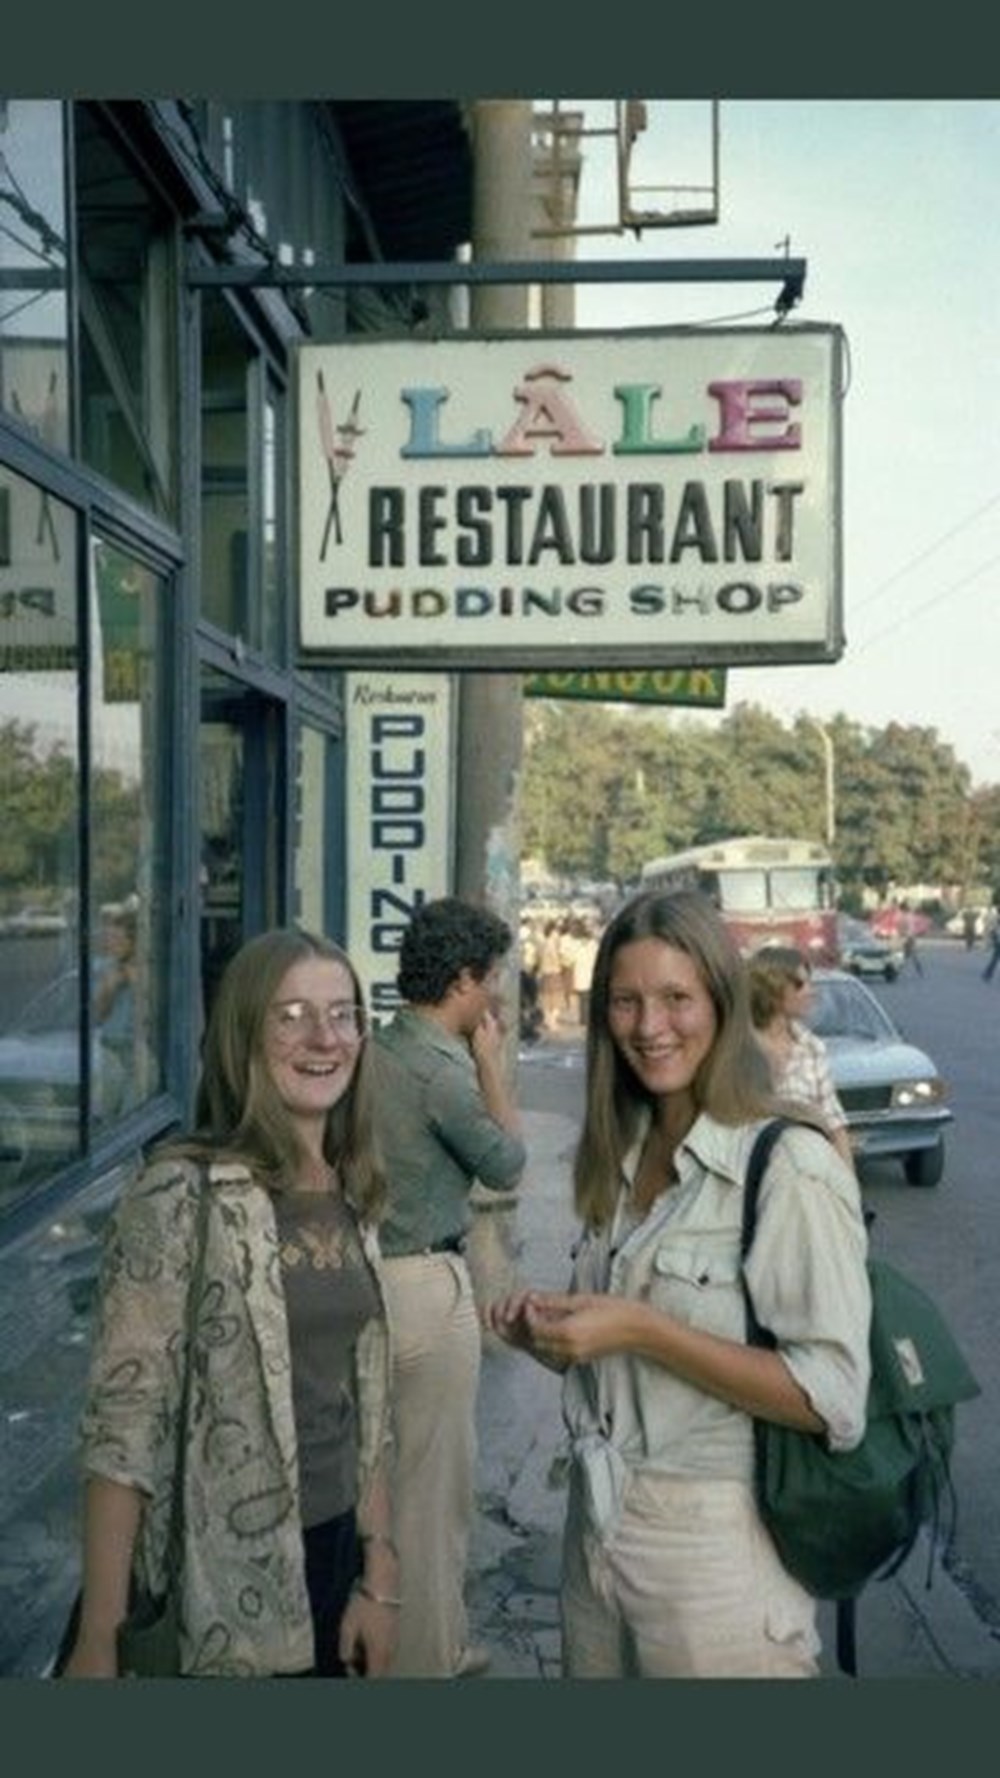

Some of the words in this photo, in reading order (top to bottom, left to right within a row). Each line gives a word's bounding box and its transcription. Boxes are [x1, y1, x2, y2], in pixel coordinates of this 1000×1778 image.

[399, 366, 804, 458] LÂLE
[367, 479, 805, 569] RESTAURANT
[323, 585, 604, 618] PUDDING
[628, 581, 804, 616] SHOP
